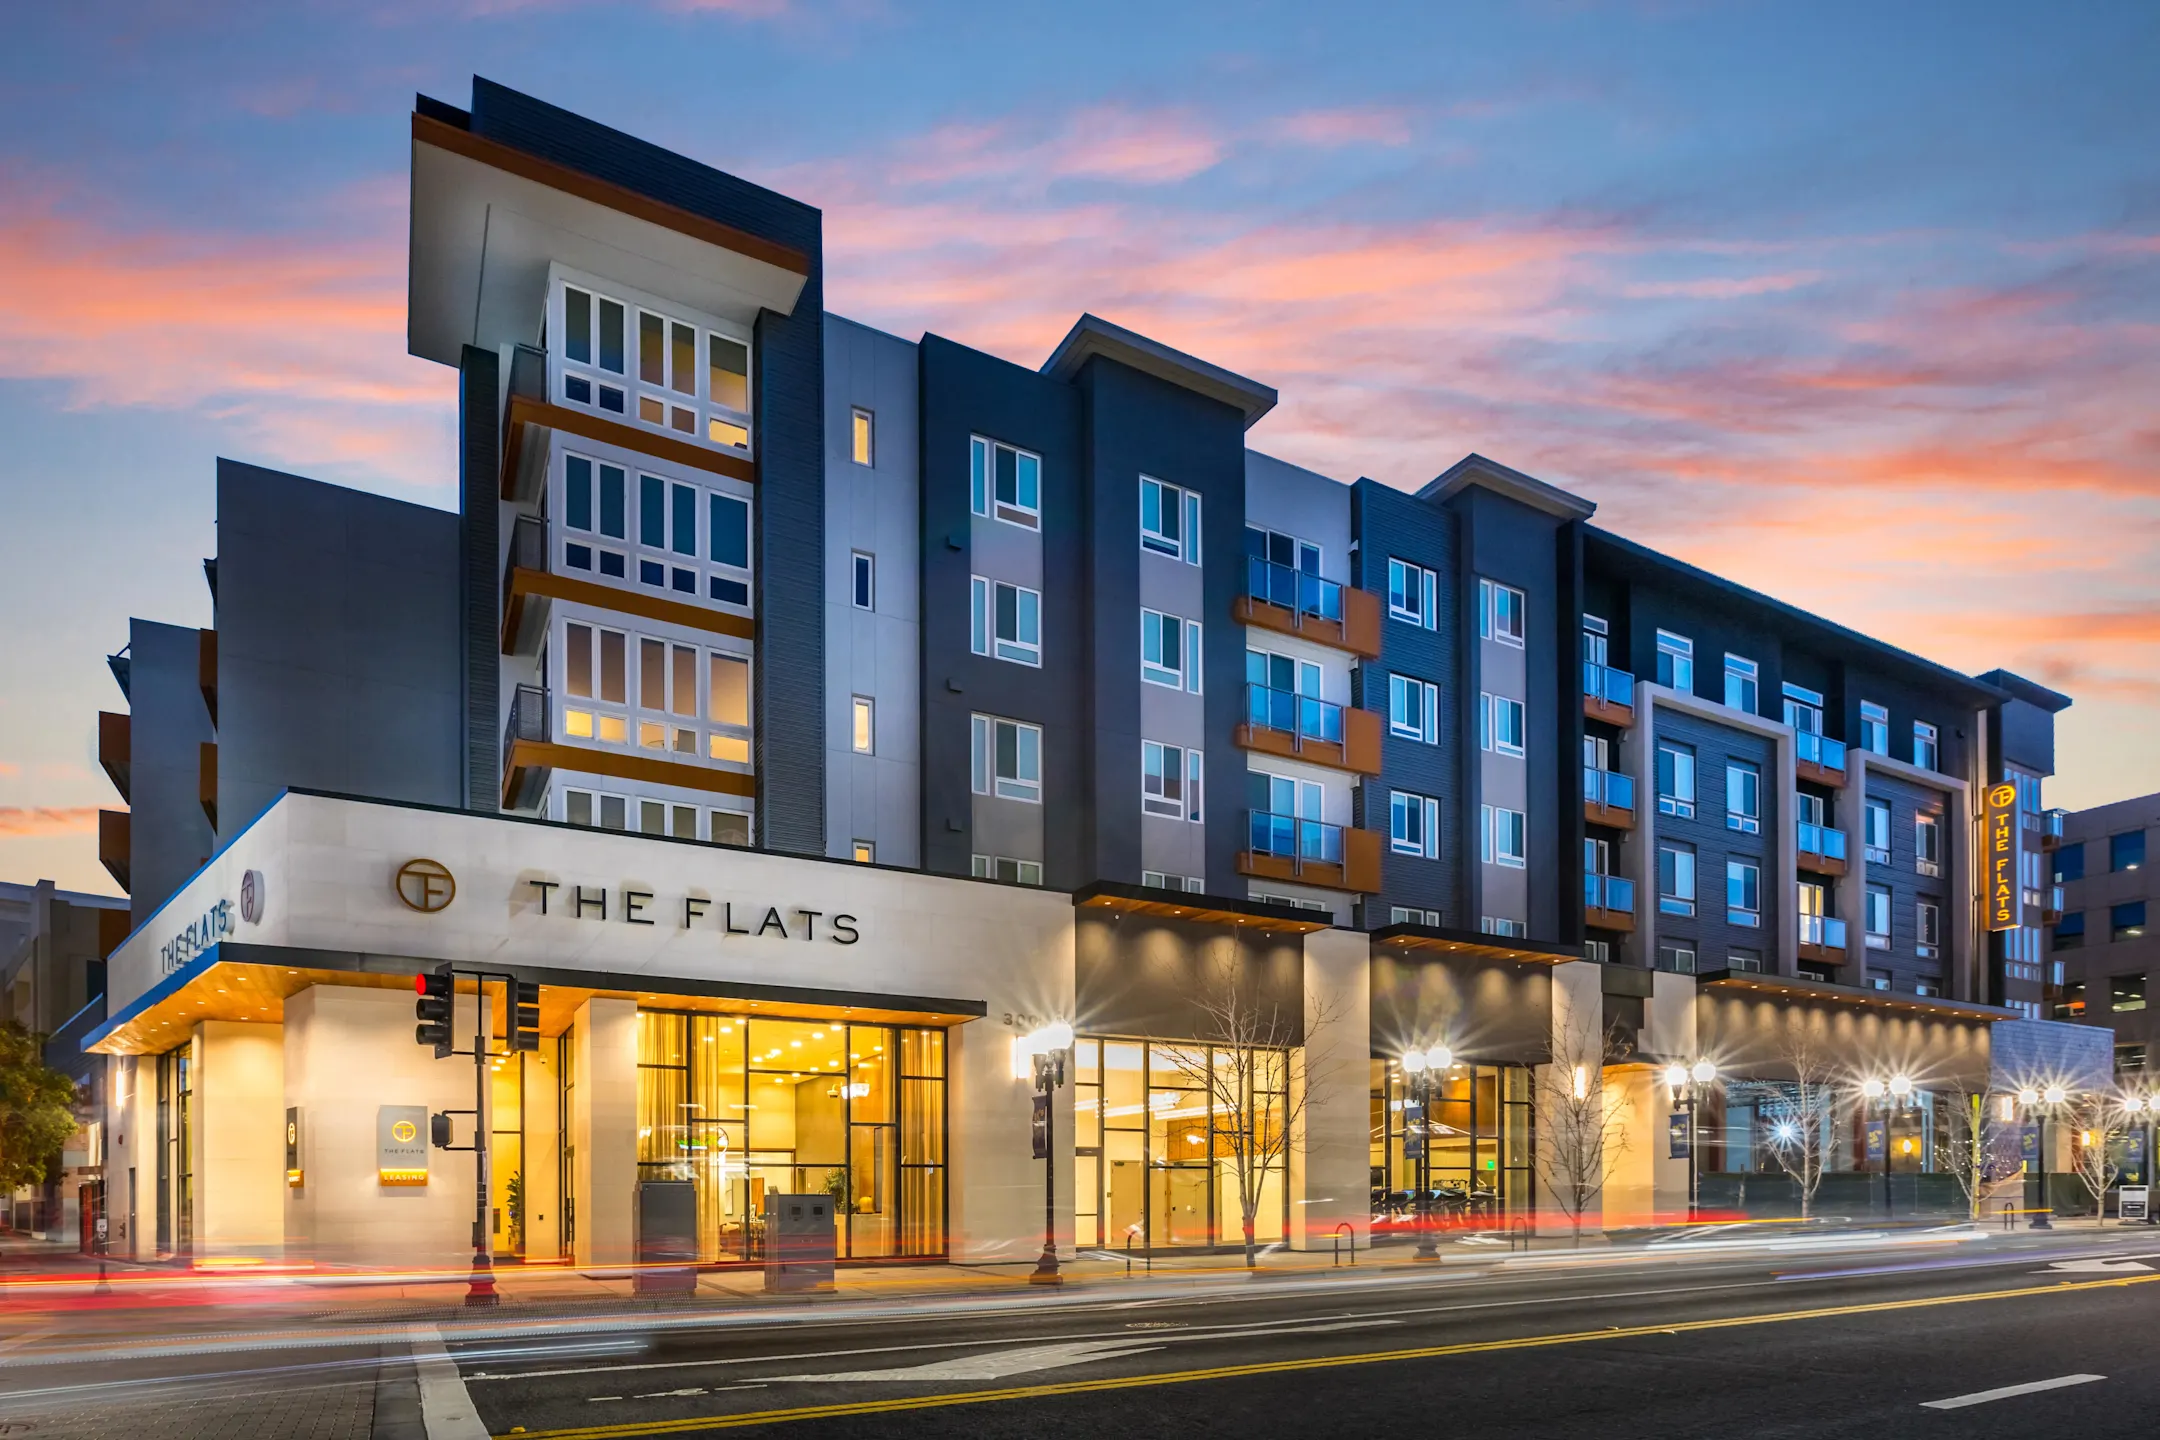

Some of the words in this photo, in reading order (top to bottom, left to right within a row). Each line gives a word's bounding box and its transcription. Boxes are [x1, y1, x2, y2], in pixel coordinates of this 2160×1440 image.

[1996, 813, 2009, 851] THE
[530, 880, 654, 925] THE
[686, 897, 859, 945] FLATS
[1996, 858, 2010, 921] FLATS
[161, 933, 182, 974] THE
[186, 899, 227, 957] FLATS
